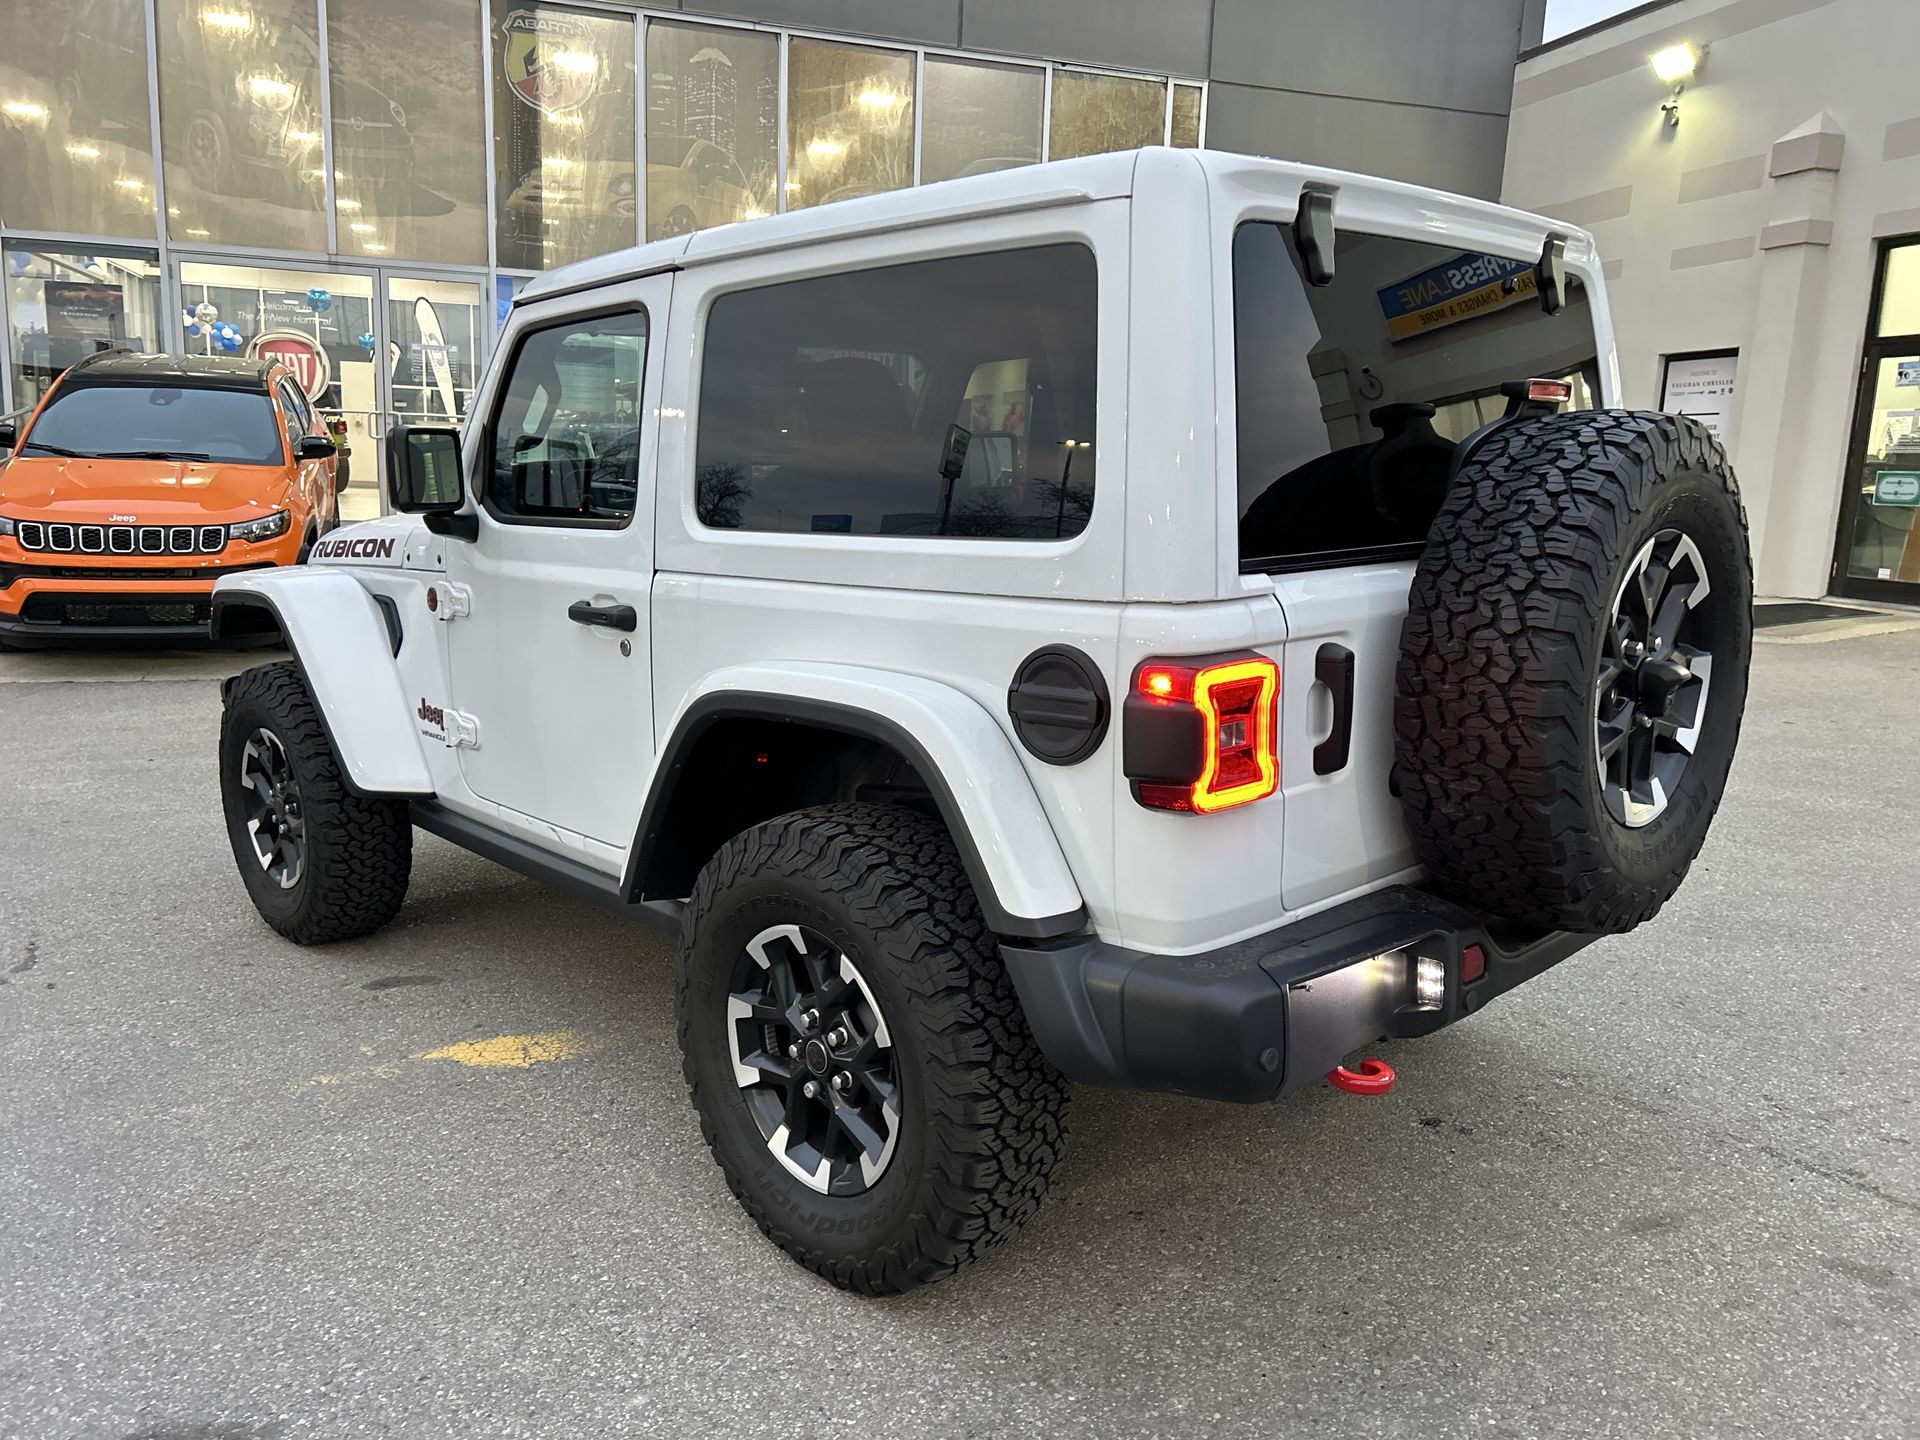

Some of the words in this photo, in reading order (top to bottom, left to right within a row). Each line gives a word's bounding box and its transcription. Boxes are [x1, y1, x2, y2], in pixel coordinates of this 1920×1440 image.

[512, 18, 582, 35] ABARTH
[257, 301, 300, 311] Welcome
[237, 311, 254, 321] The
[255, 313, 291, 323] Al-New
[1702, 379, 1734, 387] CHRYSLER
[108, 514, 137, 523] Jeep
[313, 538, 396, 559] RUBICON
